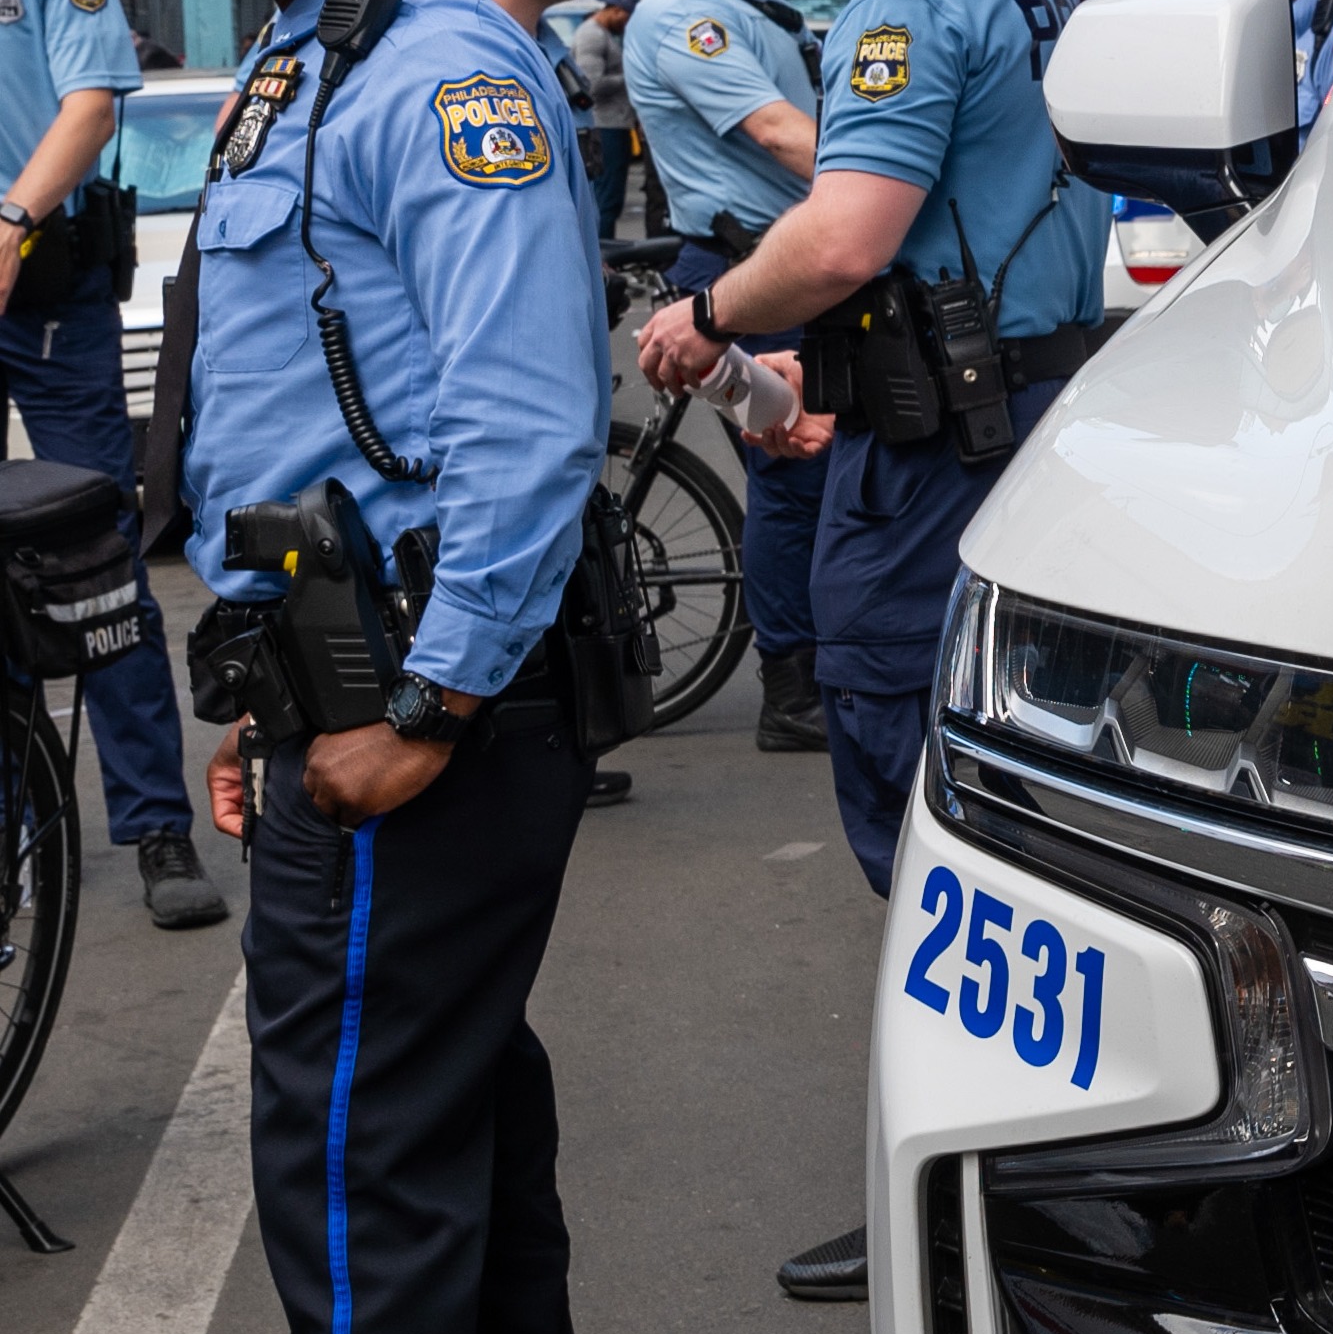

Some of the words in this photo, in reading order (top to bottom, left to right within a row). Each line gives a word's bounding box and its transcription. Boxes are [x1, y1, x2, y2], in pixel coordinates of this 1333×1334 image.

[859, 42, 906, 62] POLICE
[446, 97, 535, 134] POLICE
[85, 615, 141, 659] POLICE
[904, 865, 1105, 1091] 2531
